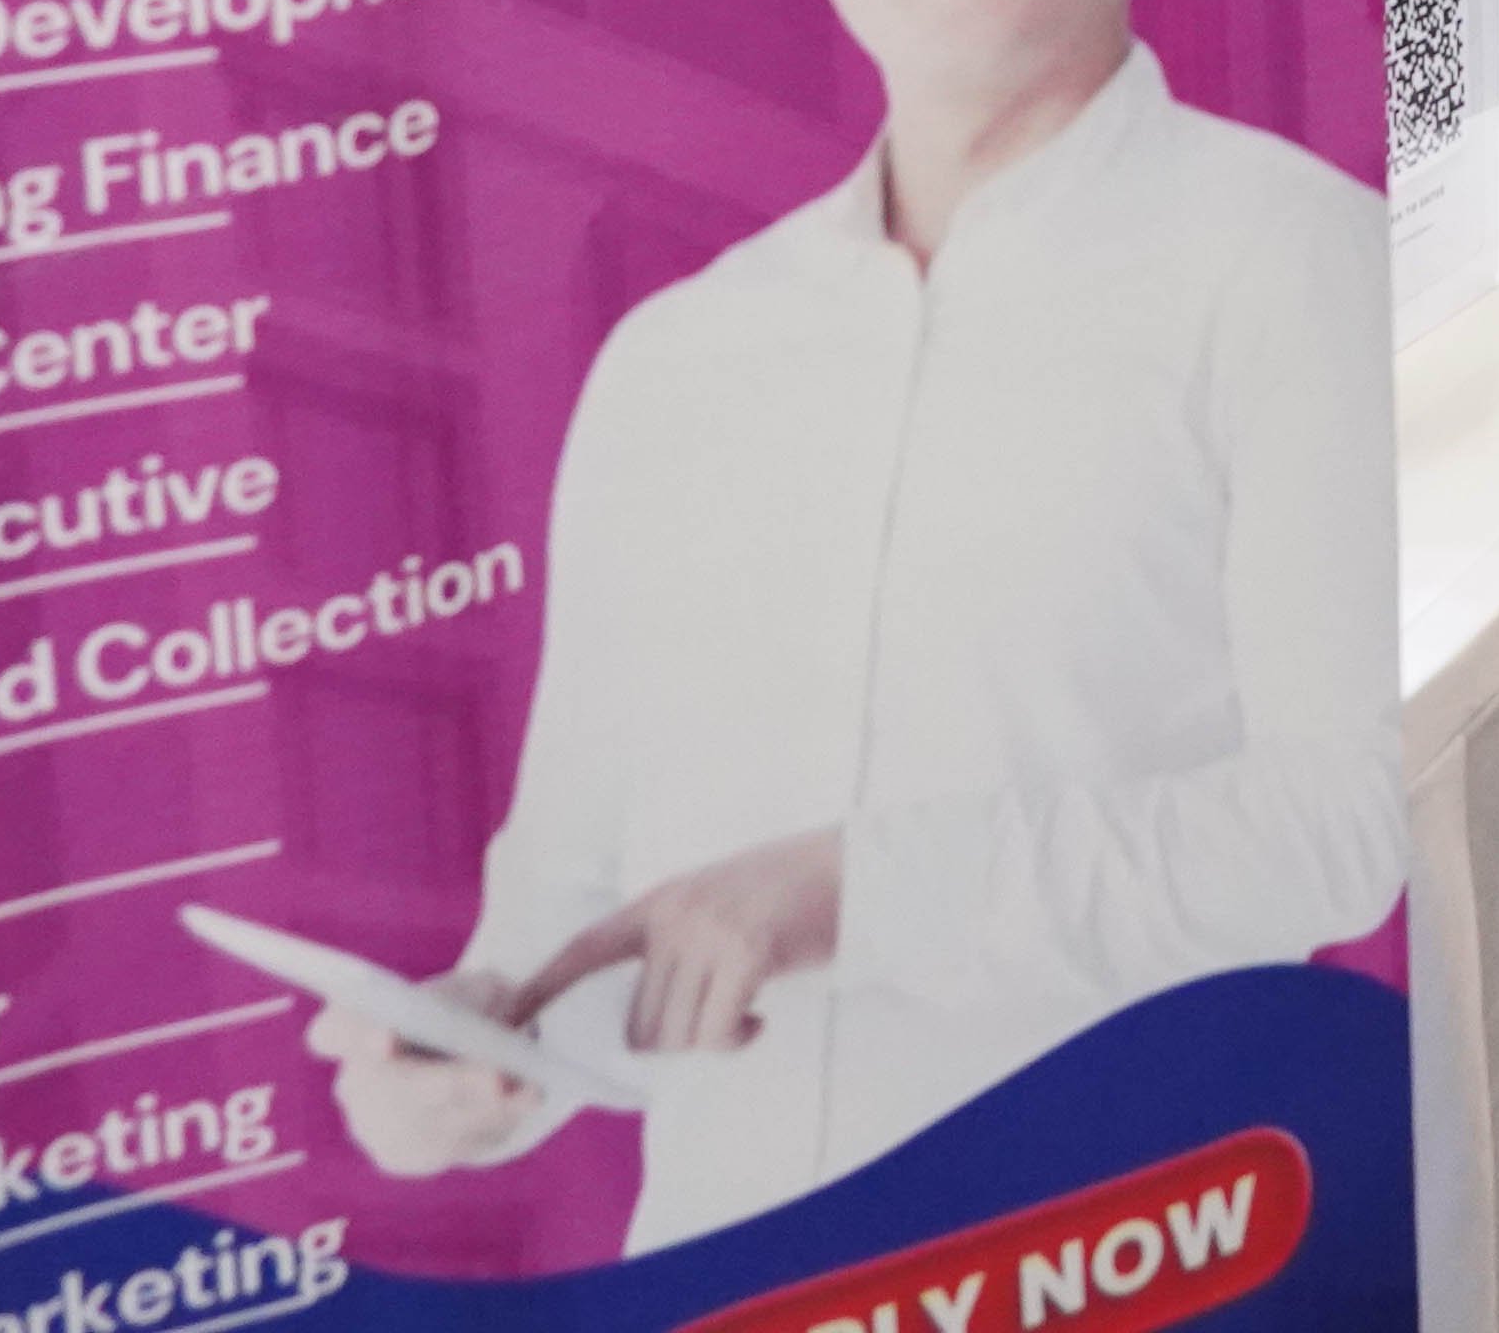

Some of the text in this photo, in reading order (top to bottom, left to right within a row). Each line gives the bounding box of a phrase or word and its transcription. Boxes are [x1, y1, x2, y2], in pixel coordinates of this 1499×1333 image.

[83, 98, 439, 215] Finance
[75, 541, 524, 697] Collection
[1019, 1172, 1257, 1331] NOW
